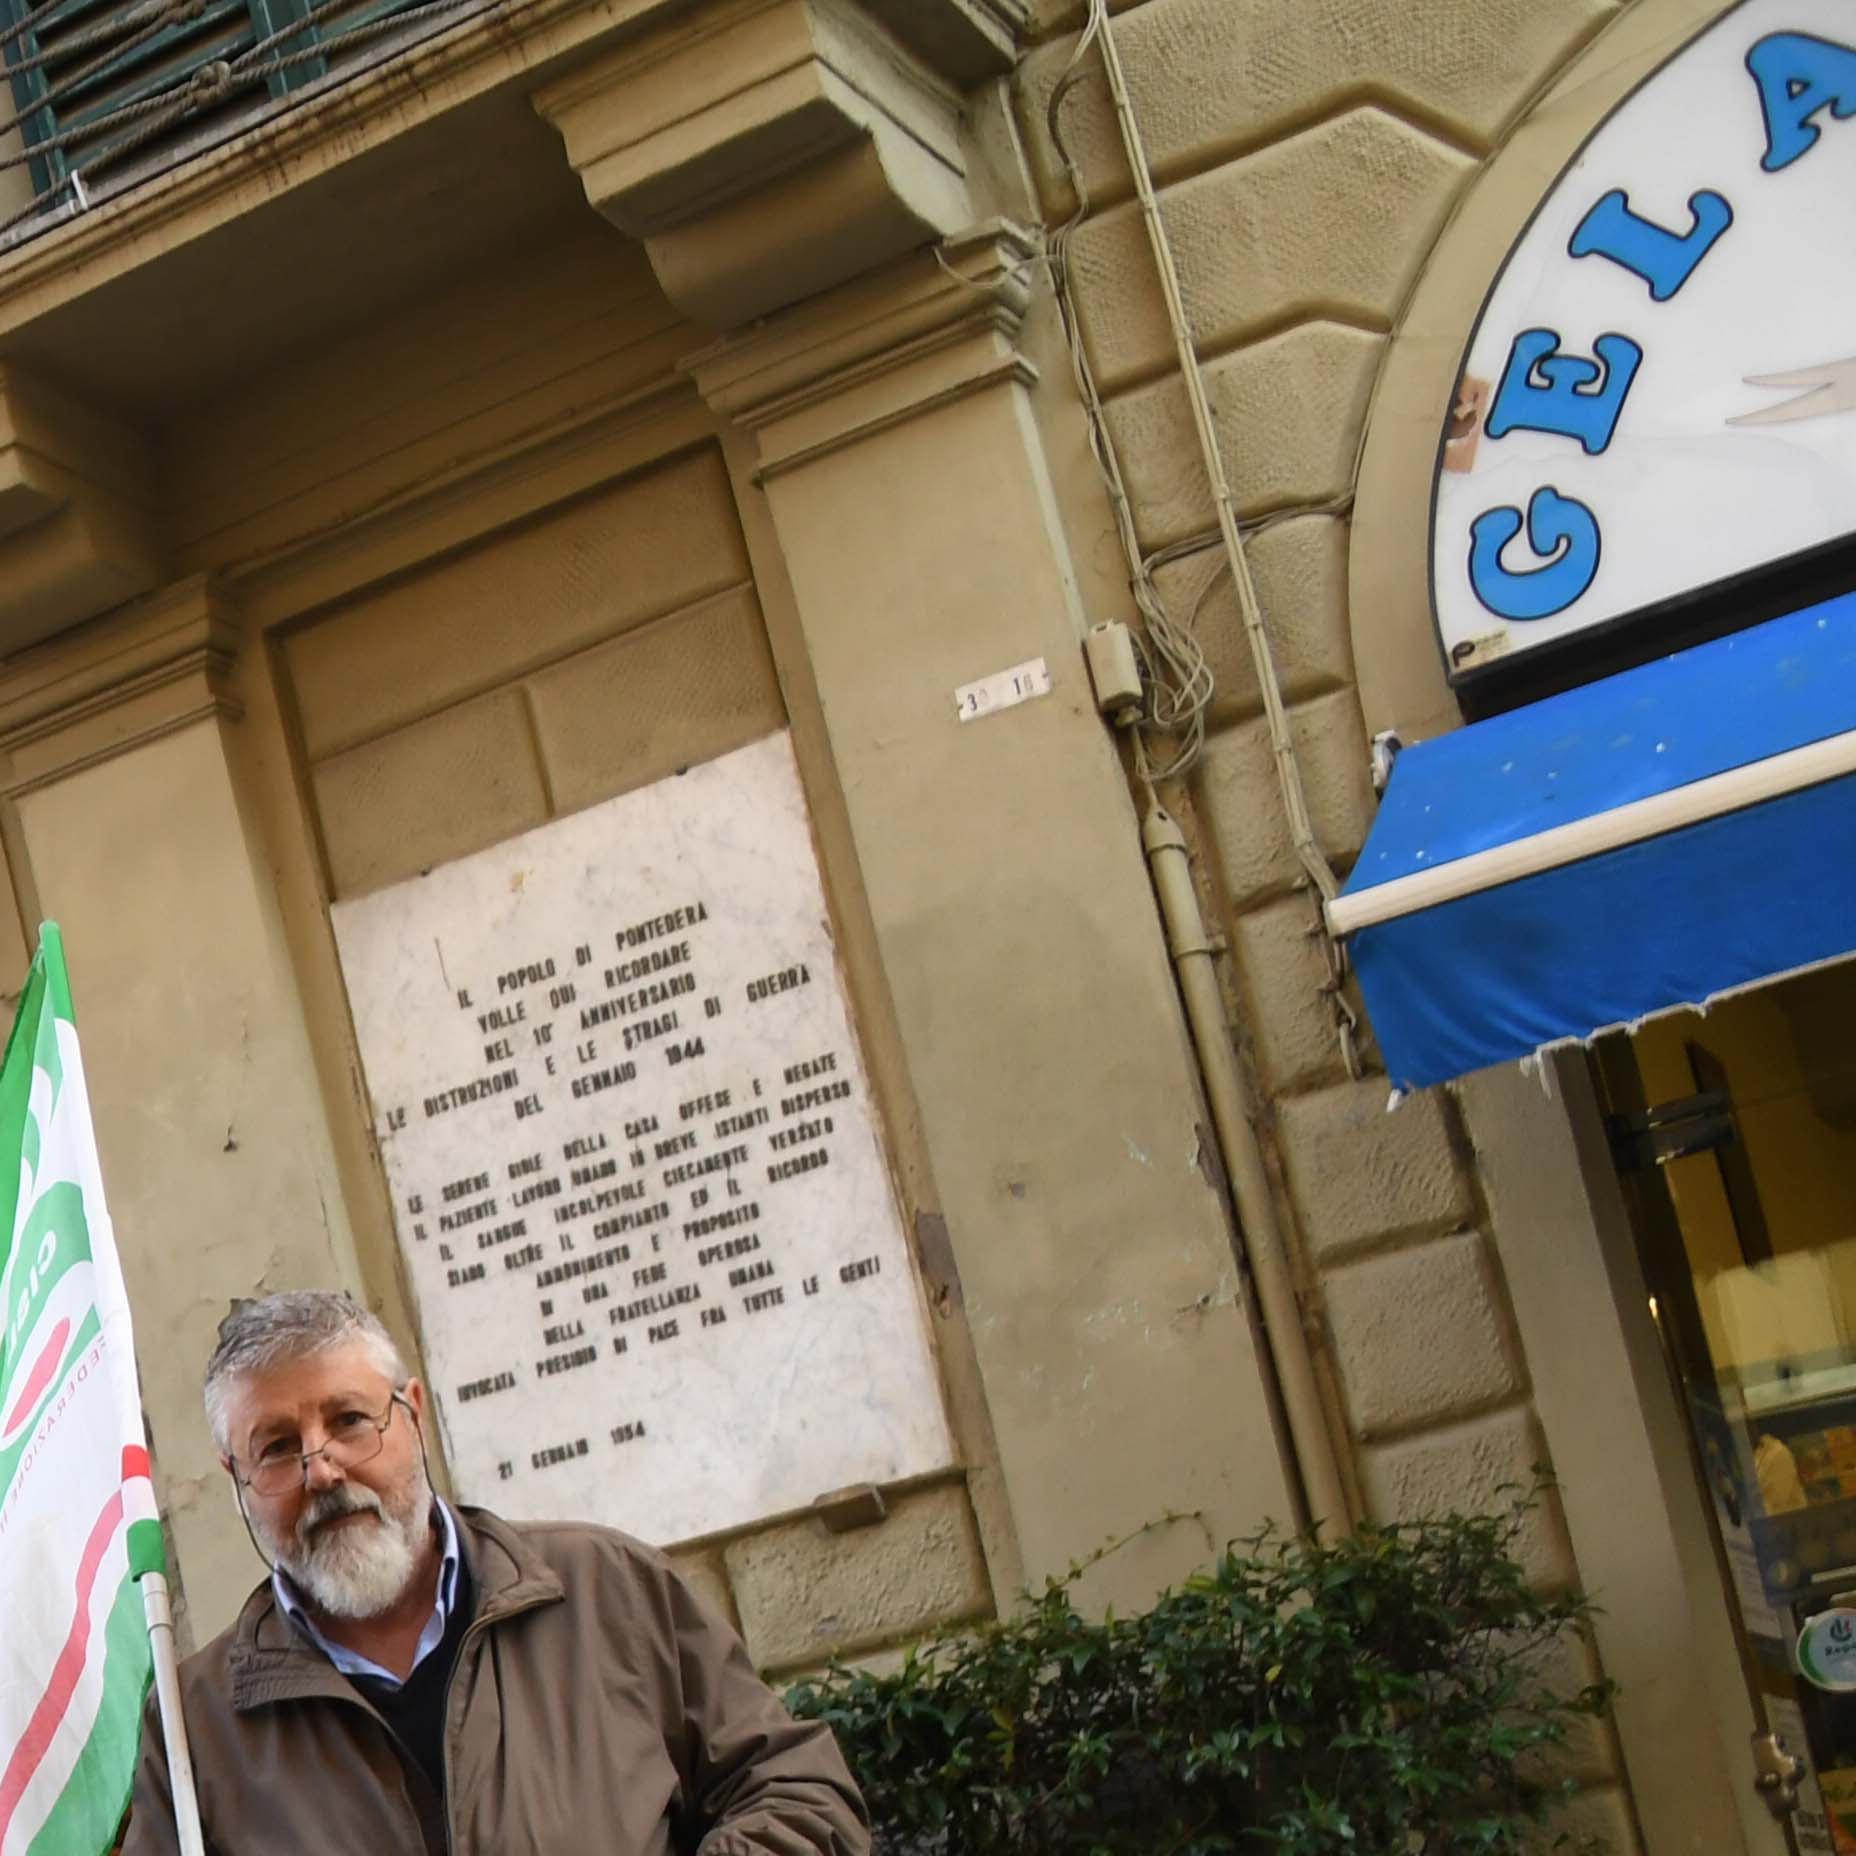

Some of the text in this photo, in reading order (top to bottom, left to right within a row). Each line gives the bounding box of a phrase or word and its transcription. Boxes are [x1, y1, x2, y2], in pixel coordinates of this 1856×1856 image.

[457, 902, 707, 1008] IL POPOLO DI PONTEDERA
[478, 941, 689, 1033] VOLLE QUI RICORDARE
[386, 965, 809, 1131] LE DISTRUZIONI E LE STRAGI DI GUERRA
[484, 1039, 513, 1063] NEL
[580, 973, 695, 1029] ANNIVERSARIO
[514, 1036, 704, 1119] DEL GENNAIO 1944
[407, 1195, 423, 1214] LE
[563, 1133, 606, 1160] DELLA
[624, 1115, 658, 1139] CASA
[678, 1089, 730, 1120] OFFESE
[752, 1078, 761, 1096] E
[783, 1052, 835, 1084] NEGATE
[413, 1224, 427, 1240] IL
[439, 1199, 497, 1231] PAZIENTE
[512, 1177, 561, 1207] LAVORO
[629, 1146, 645, 1167] IN
[715, 1107, 769, 1138] ISTANTI
[780, 1080, 850, 1116] DISPERSO
[439, 1244, 453, 1260] IL
[554, 1180, 644, 1222] INCOLPEVOLE
[769, 1117, 833, 1150] VERSATO
[504, 1244, 542, 1269] OLTRE
[559, 1234, 574, 1251] IL
[593, 1201, 669, 1239] COMPIANTO
[726, 1178, 741, 1196] IL
[767, 1148, 828, 1183] RICORDO
[650, 1233, 659, 1252] E
[683, 1202, 759, 1239] PROPOSITO
[536, 1345, 596, 1377] PRESIDIO
[612, 1336, 627, 1354] DI
[648, 1319, 679, 1343] PACE
[700, 1306, 726, 1326] FRA
[742, 1287, 783, 1313] TUTTE
[802, 1275, 818, 1295] LE
[839, 1256, 880, 1283] GENTI
[539, 1299, 553, 1317] DI
[632, 1262, 666, 1286] FEDE
[698, 1233, 760, 1266] OPEROSA
[609, 1284, 700, 1324] FRATELLANZA
[728, 1260, 774, 1287] UMANA
[497, 1461, 512, 1480] 21
[531, 1438, 588, 1468] GENNAIO
